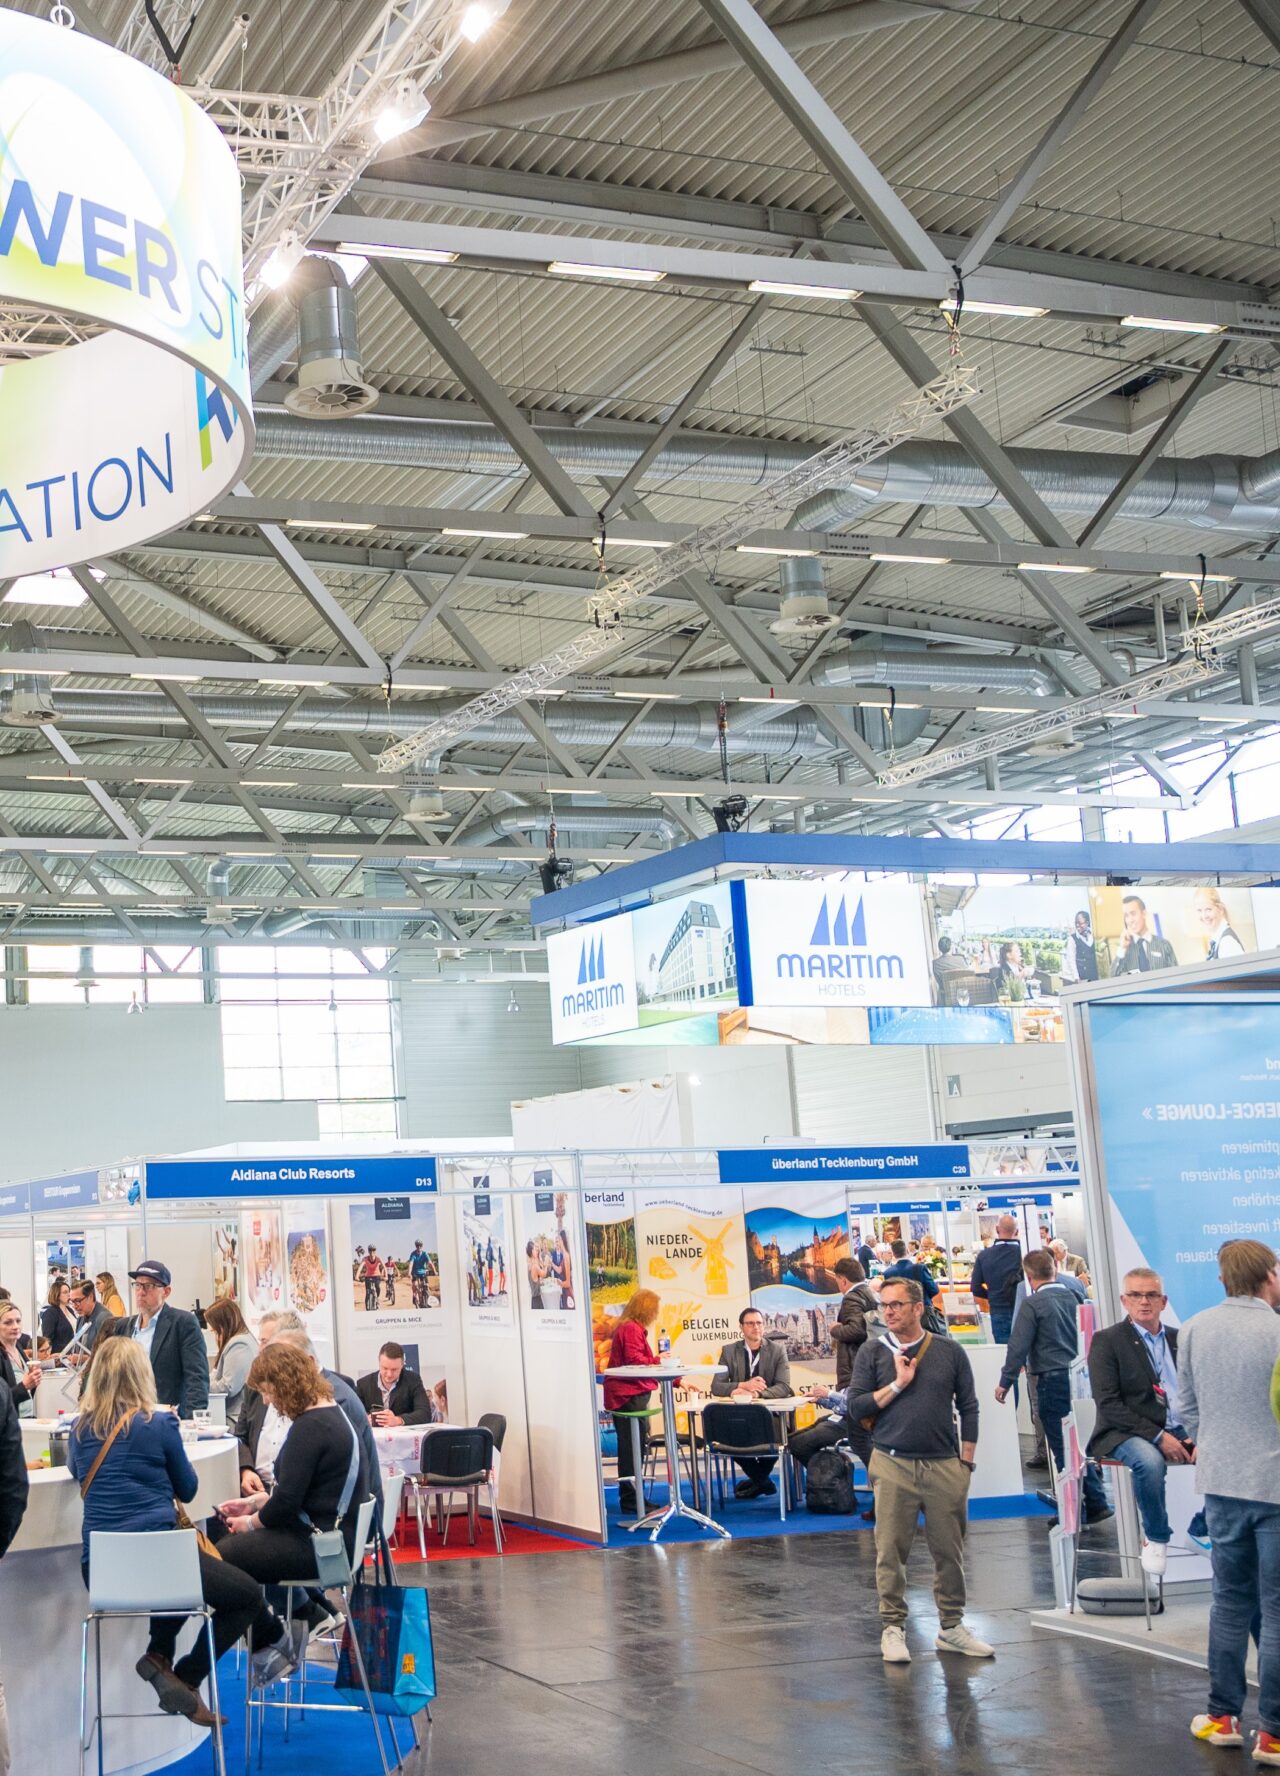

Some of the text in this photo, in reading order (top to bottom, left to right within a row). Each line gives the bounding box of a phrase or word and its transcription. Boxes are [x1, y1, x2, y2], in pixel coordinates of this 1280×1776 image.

[776, 953, 905, 979] MARITIM
[818, 983, 867, 997] HOTELS
[562, 982, 625, 1018] MARITIM
[772, 1155, 918, 1170] überland Tecklenburg GmbH
[230, 1167, 355, 1181] Aldiana Club Resorts
[952, 1166, 967, 1174] C20
[416, 1178, 432, 1187] D13
[584, 1191, 625, 1202] berland
[646, 1234, 694, 1246] NIEDER-
[665, 1247, 703, 1259] LANDE
[683, 1318, 730, 1331] BELGIEN
